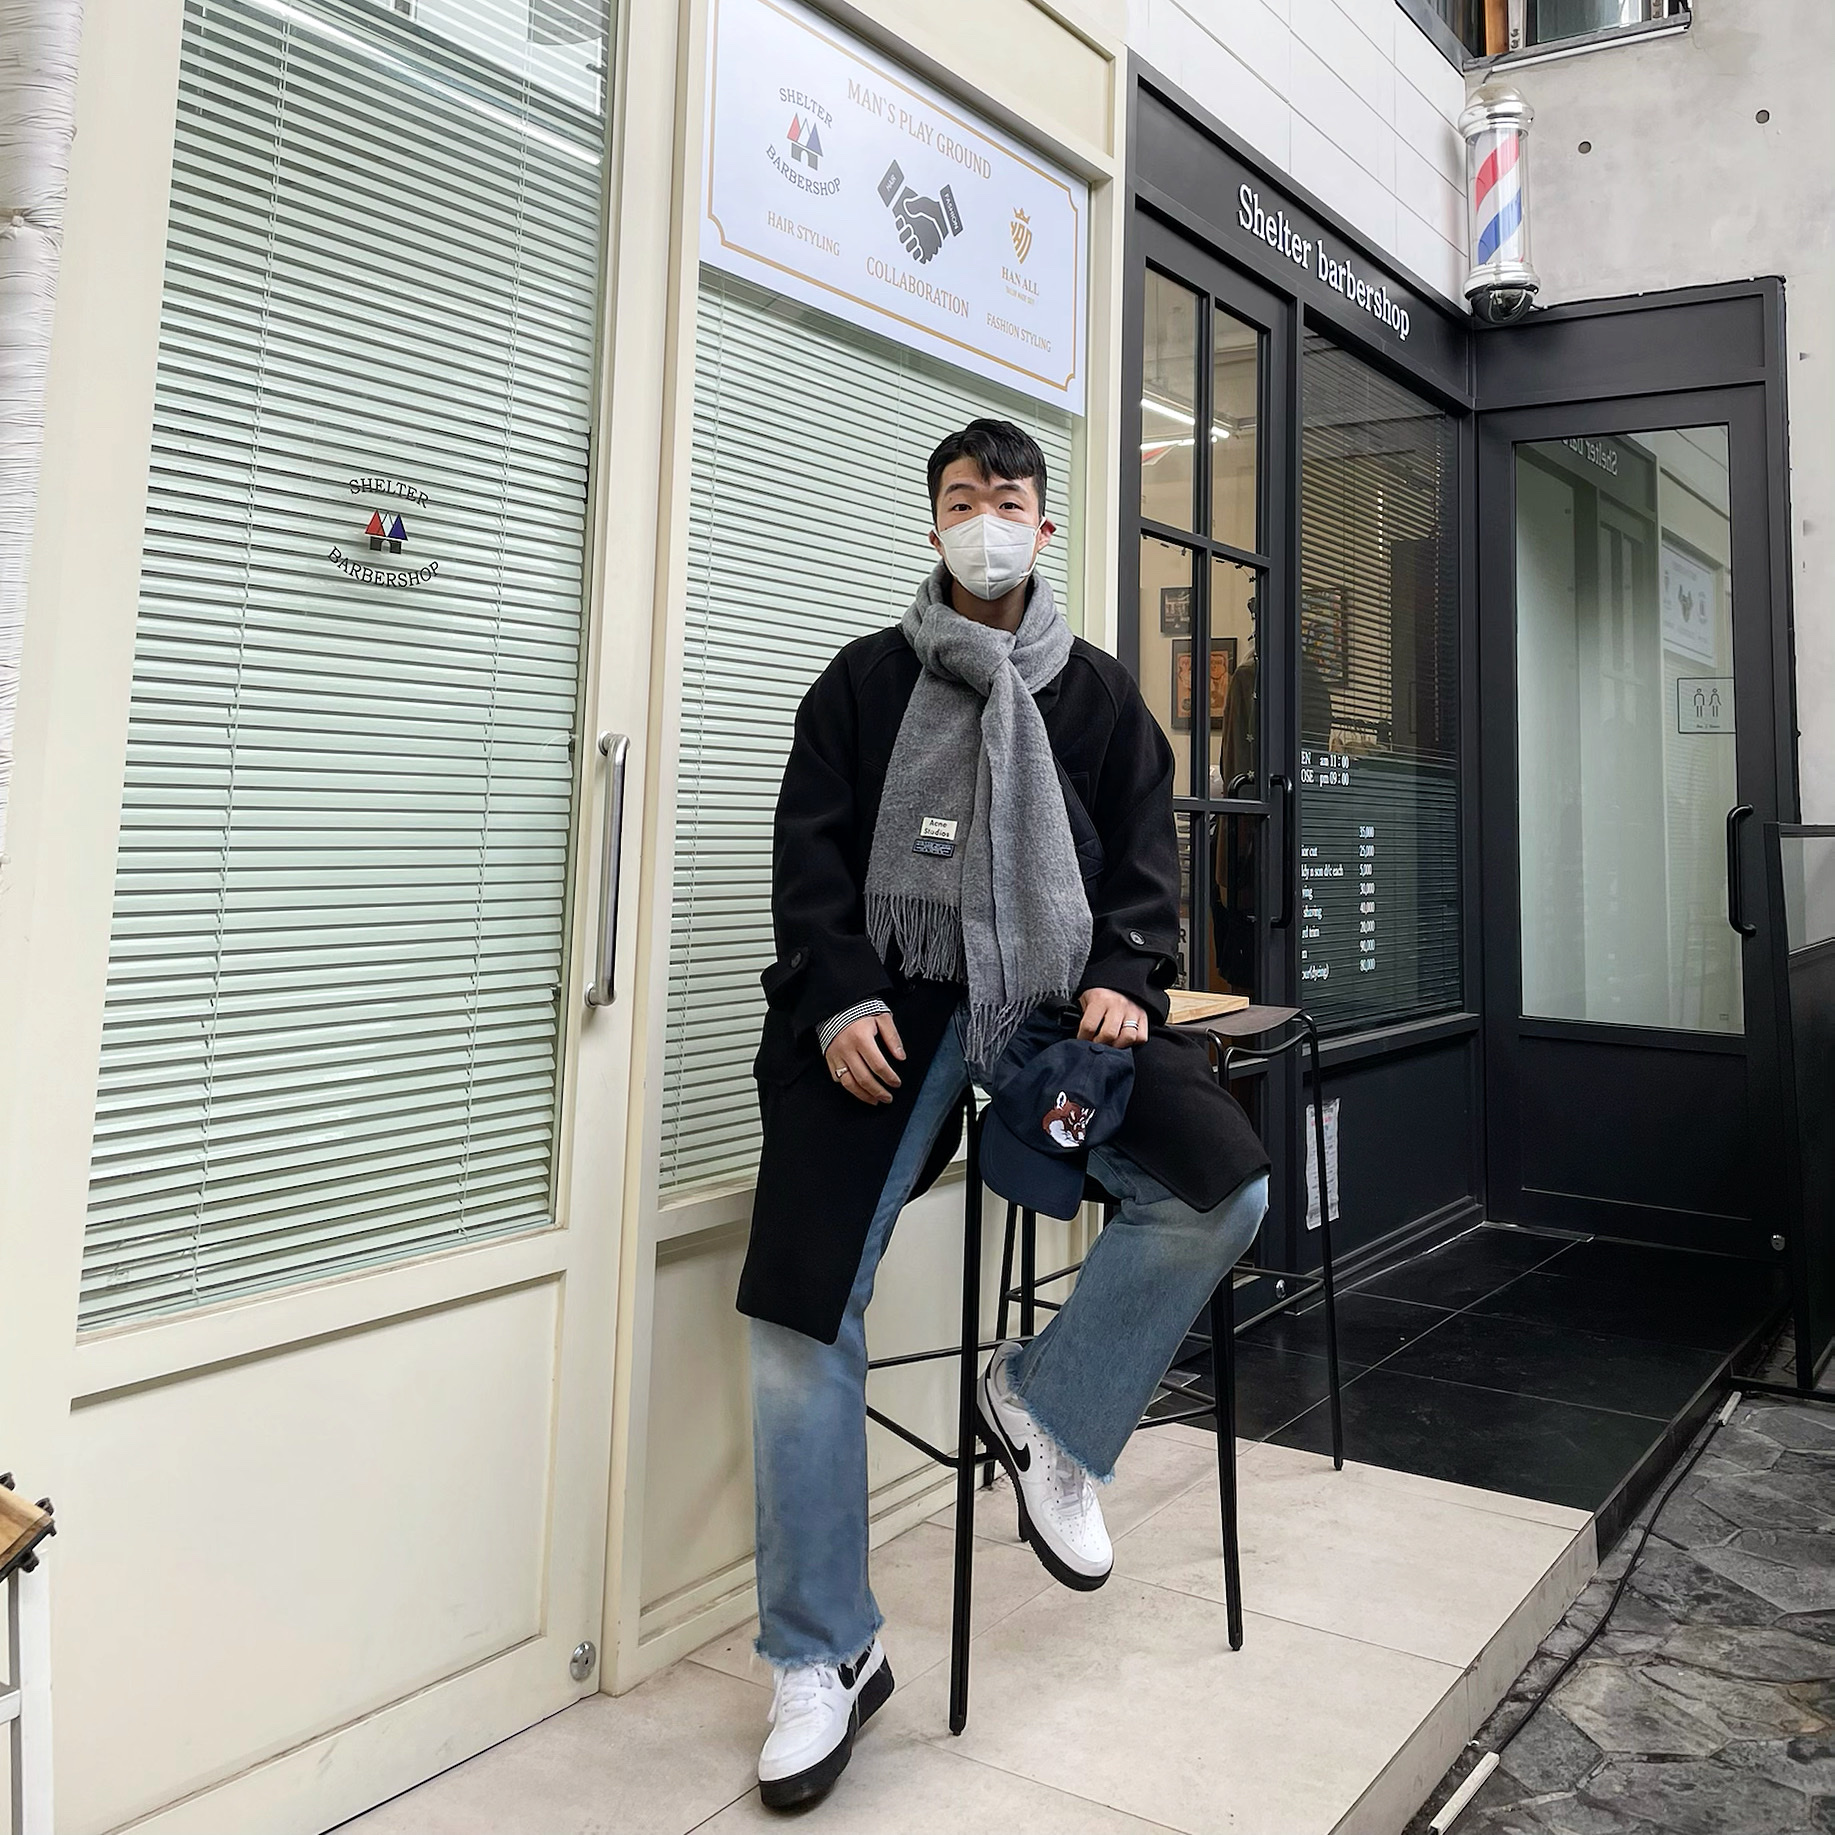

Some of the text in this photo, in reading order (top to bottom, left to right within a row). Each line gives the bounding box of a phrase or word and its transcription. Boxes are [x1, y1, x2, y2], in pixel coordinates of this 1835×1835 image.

[779, 87, 833, 129] SHELTER
[899, 109, 934, 146] PLAY
[936, 132, 991, 179] GROUND
[766, 144, 841, 196] BARBERSHOP
[944, 192, 959, 231] FASHION
[767, 210, 840, 256] HAIR STYLING
[1001, 265, 1021, 286] HAN
[1021, 278, 1040, 296] ALL
[1238, 183, 1411, 341] Shelter barbershop
[866, 256, 969, 319] COLLABORATION
[986, 312, 1051, 352] FASHION STYLING
[349, 477, 430, 509] SHELTER
[327, 545, 440, 588] BARBERSHOP
[924, 828, 950, 838] Studios
[929, 820, 948, 828] Acne
